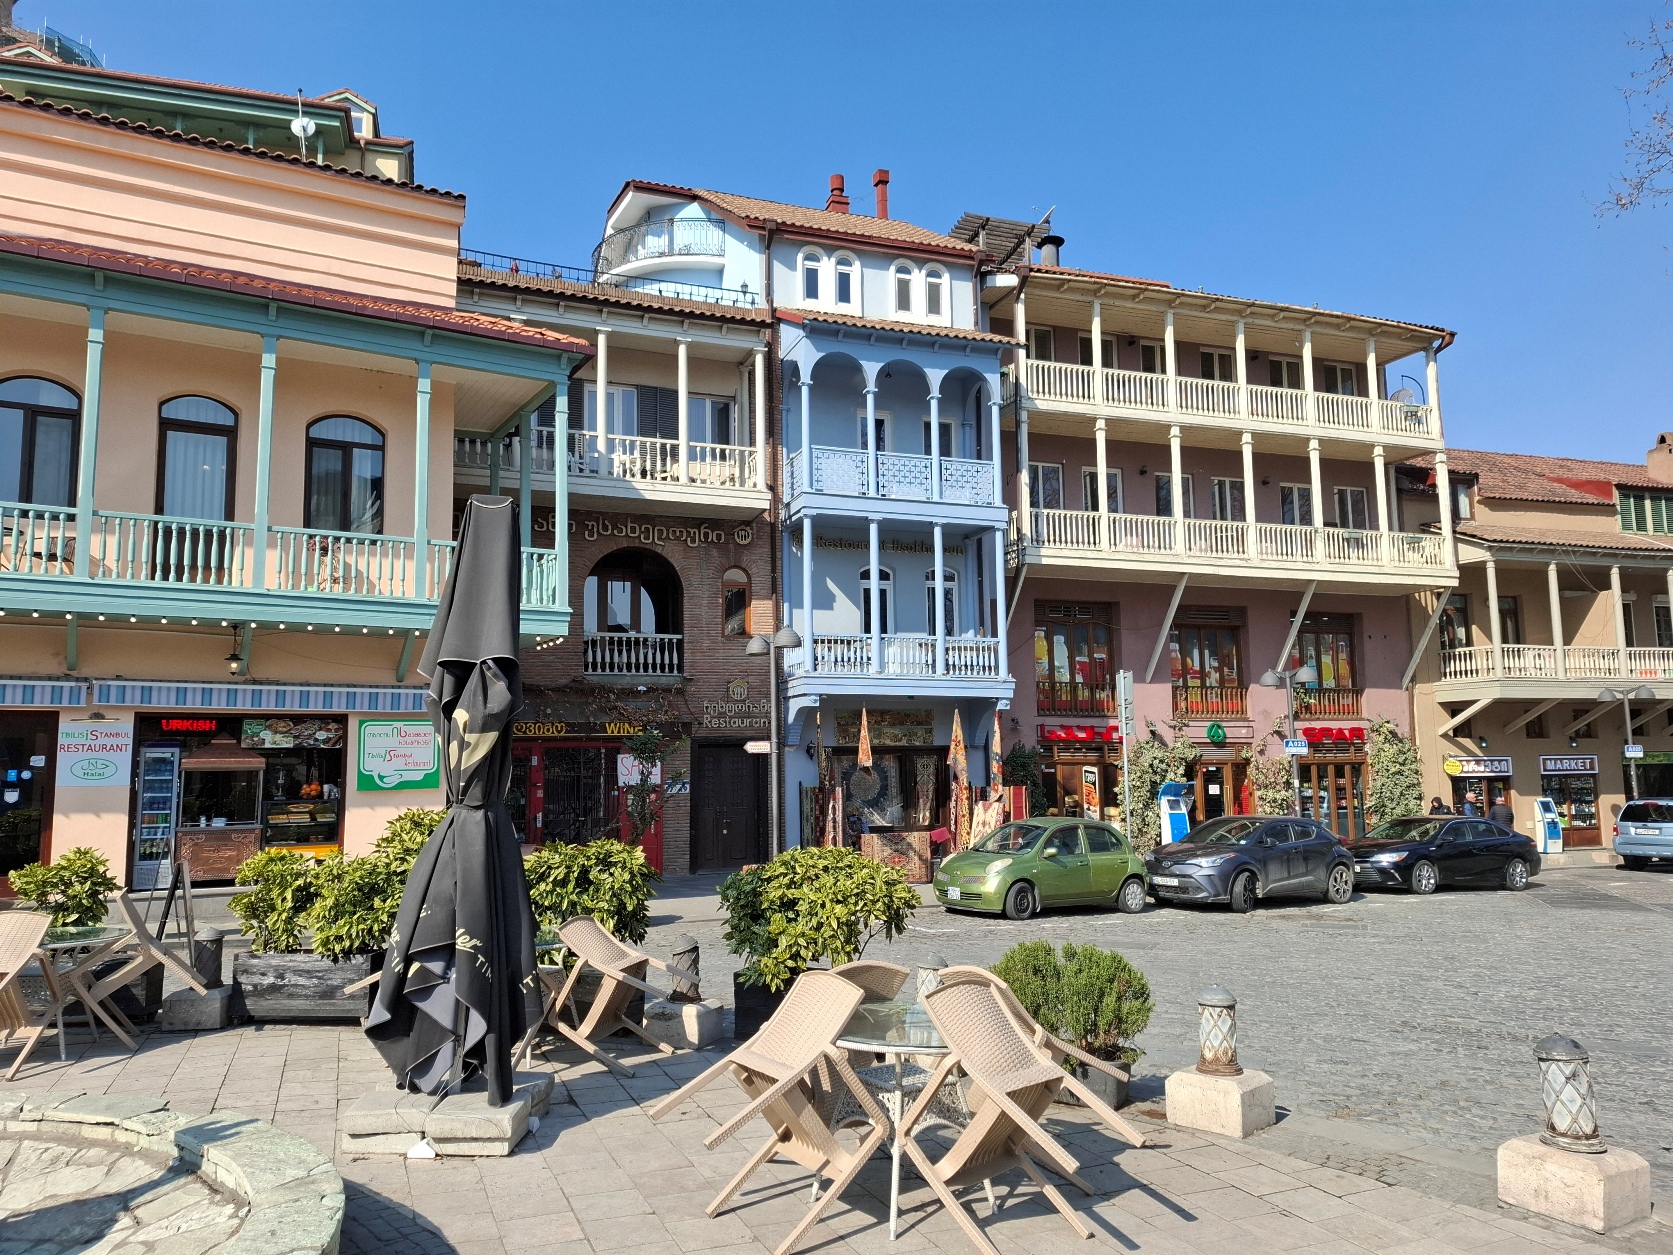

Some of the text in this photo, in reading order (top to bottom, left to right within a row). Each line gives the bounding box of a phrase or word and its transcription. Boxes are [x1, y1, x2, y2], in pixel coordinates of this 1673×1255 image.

[703, 699, 772, 716] რესტორან
[703, 714, 772, 728] Restauran
[605, 722, 643, 736] WINE
[1302, 726, 1365, 743] SPAR
[59, 744, 130, 753] RESTAURANT
[1462, 760, 1508, 772] არკეტი
[1545, 759, 1591, 770] MARKET
